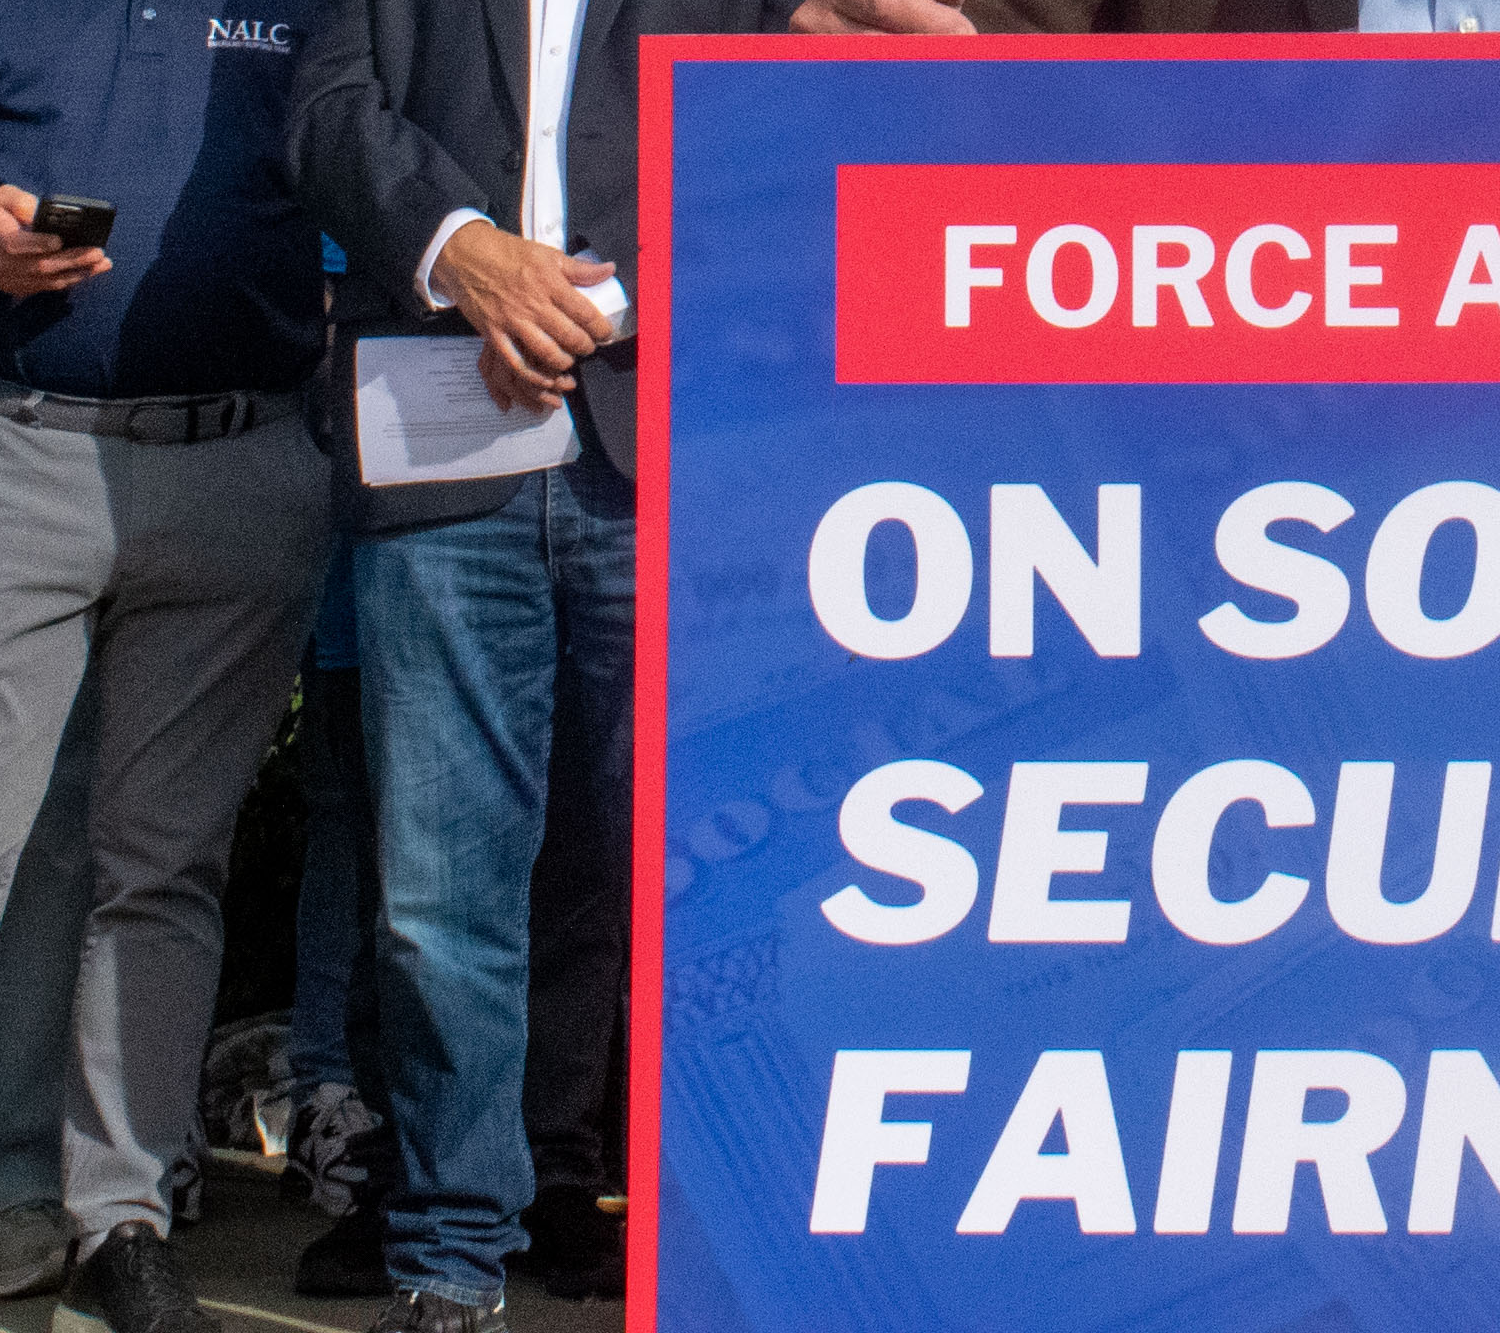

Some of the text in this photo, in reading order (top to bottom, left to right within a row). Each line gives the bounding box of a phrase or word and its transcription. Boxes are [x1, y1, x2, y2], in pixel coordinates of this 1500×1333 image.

[208, 18, 291, 45] NALC
[944, 223, 1400, 329] FORCE
[808, 481, 1142, 660] ON
